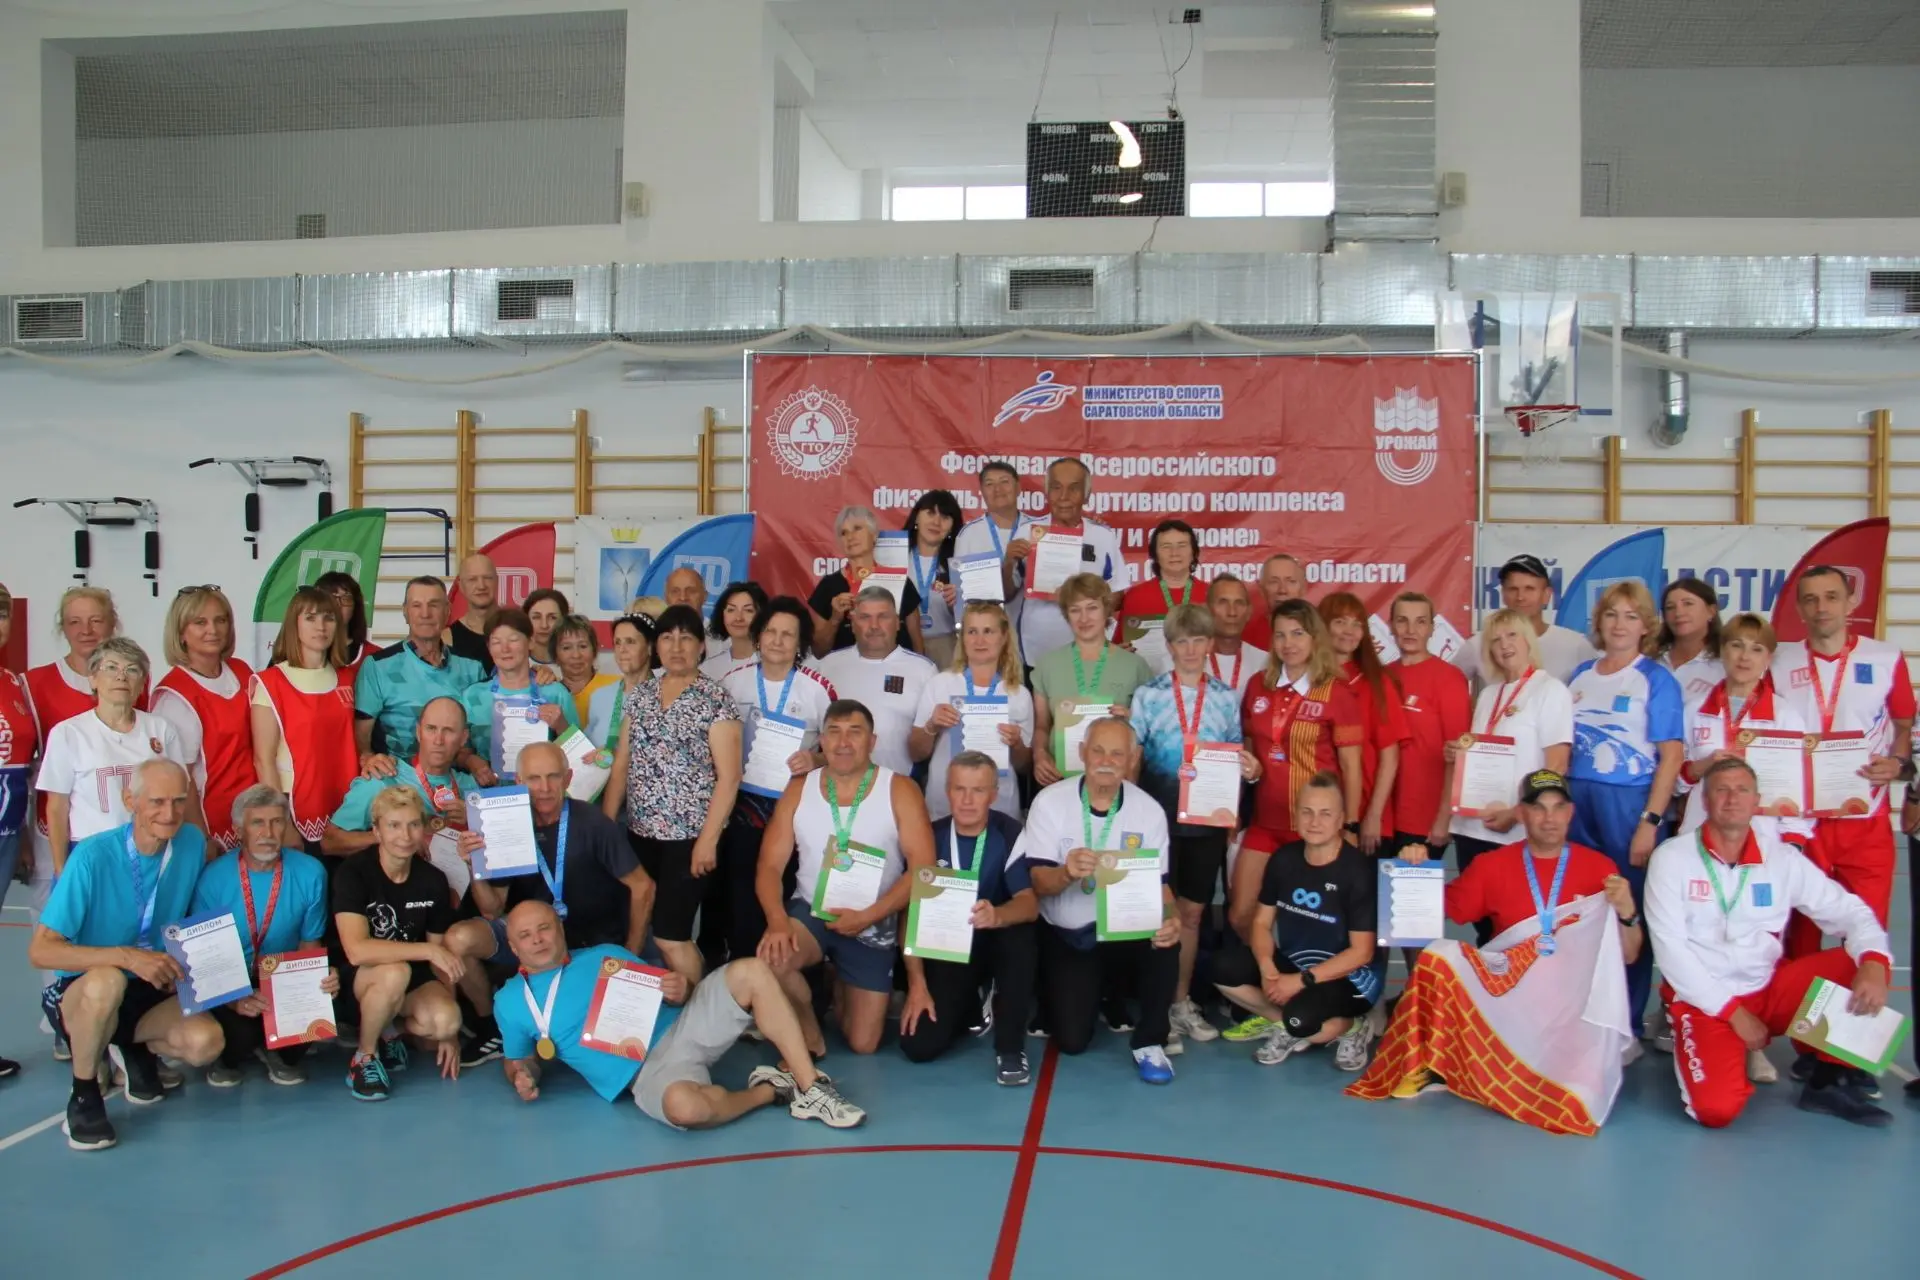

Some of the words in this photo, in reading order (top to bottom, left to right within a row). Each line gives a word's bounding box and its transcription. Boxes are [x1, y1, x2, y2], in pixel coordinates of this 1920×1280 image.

[1041, 125, 1077, 134] ХОЗЯЕВА
[1141, 124, 1167, 133] ГОСТИ
[1091, 165, 1102, 174] 24
[1042, 173, 1069, 182] ФОЛЫ
[1142, 172, 1170, 181] ФОЛЫ
[1084, 387, 1174, 400] МИНИСТЕРСТВО
[1176, 387, 1221, 400] СПОРТА
[1084, 403, 1165, 418] САРАТОВСКОЙ
[1168, 404, 1221, 418] ОБЛАСТИ
[1375, 433, 1437, 450] УРОЖАЙ
[801, 442, 824, 453] ГТО
[1210, 491, 1346, 512] комплекса
[1305, 561, 1407, 583] области
[486, 796, 519, 807] ДИПЛОМ
[185, 918, 223, 938] ДИПЛОМ
[285, 959, 322, 970] ДИПЛОМ
[625, 971, 662, 986] ДИПЛОМ
